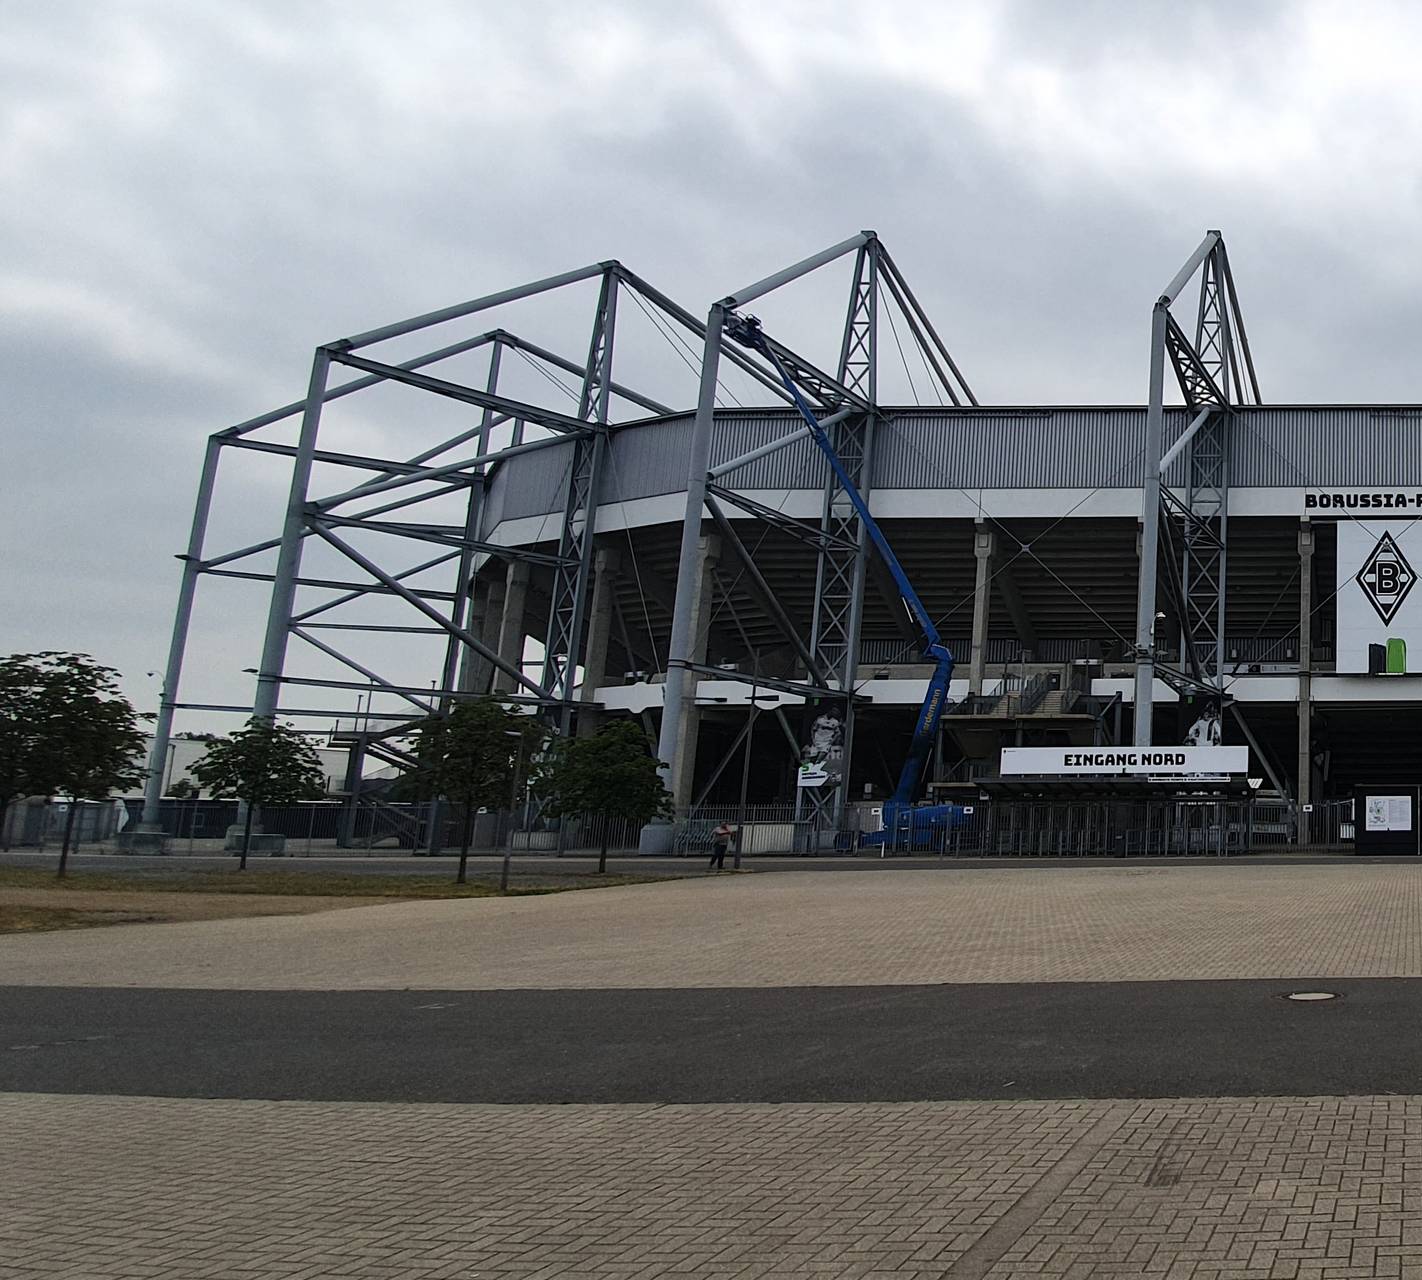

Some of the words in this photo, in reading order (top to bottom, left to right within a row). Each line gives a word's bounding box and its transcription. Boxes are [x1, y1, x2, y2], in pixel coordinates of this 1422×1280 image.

[1376, 562, 1400, 595] B
[1063, 753, 1138, 767] EINGANG
[1141, 753, 1186, 766] NORD
